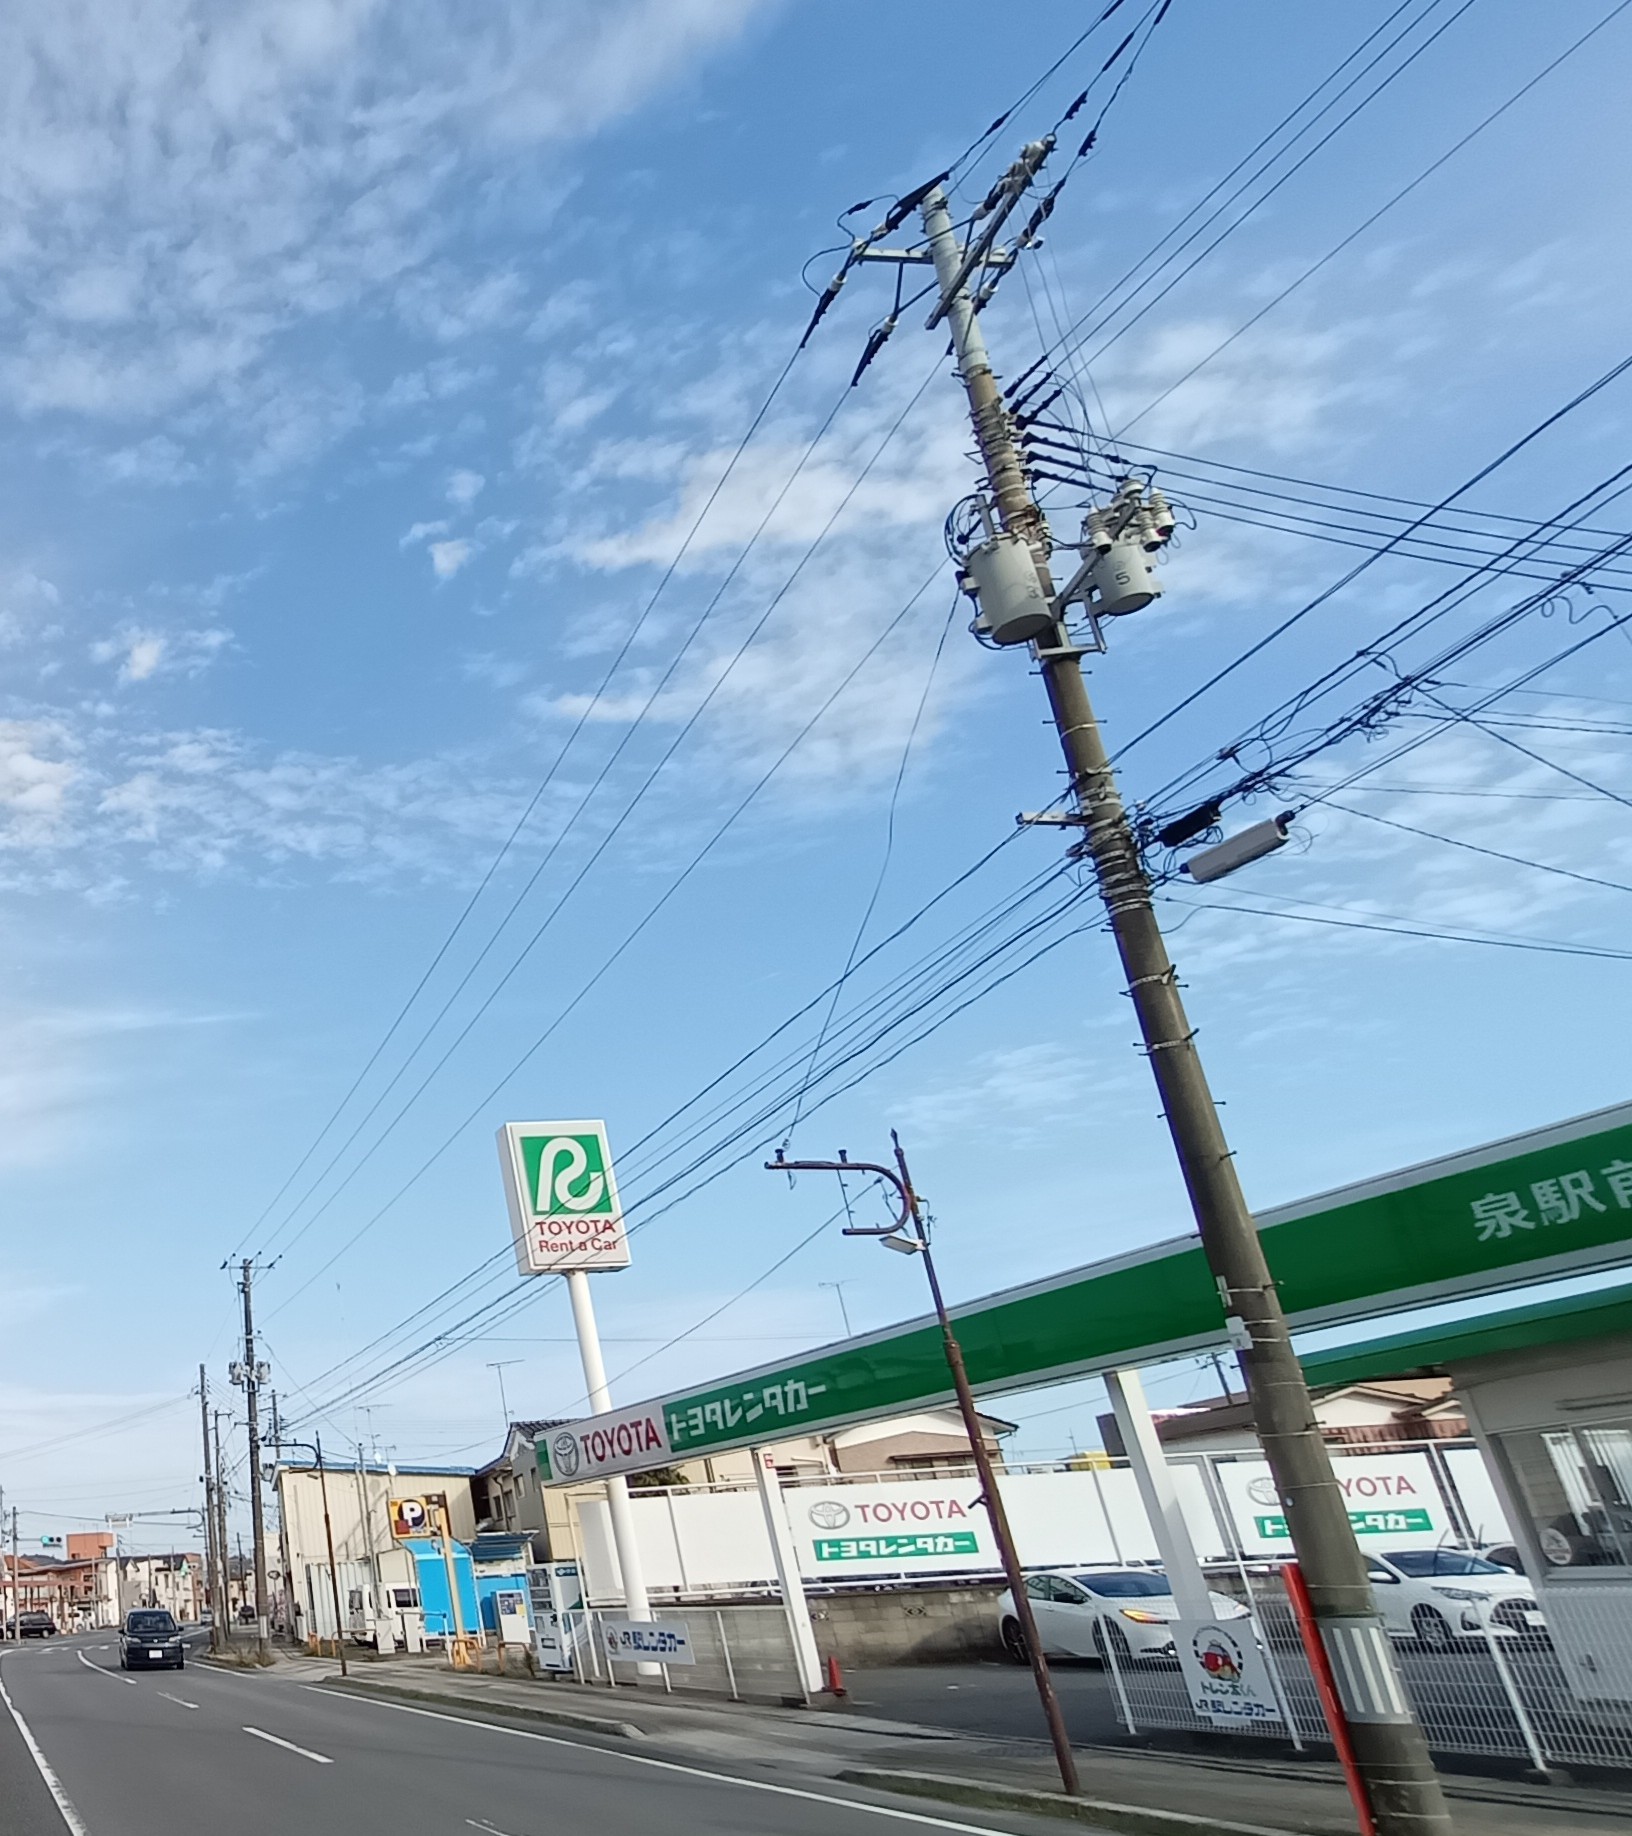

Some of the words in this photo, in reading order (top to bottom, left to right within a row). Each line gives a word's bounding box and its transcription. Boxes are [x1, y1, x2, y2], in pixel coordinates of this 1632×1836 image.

[535, 1219, 617, 1236] TOYOTA
[538, 1239, 574, 1253] Rent
[591, 1237, 617, 1251] Car
[670, 1378, 828, 1442] トヨタレンタカー
[578, 1416, 663, 1465] TOYOTA
[1337, 1474, 1417, 1498] YOTA
[854, 1499, 968, 1523] TOYOTA
[821, 1535, 972, 1558] トヨタレンタカー
